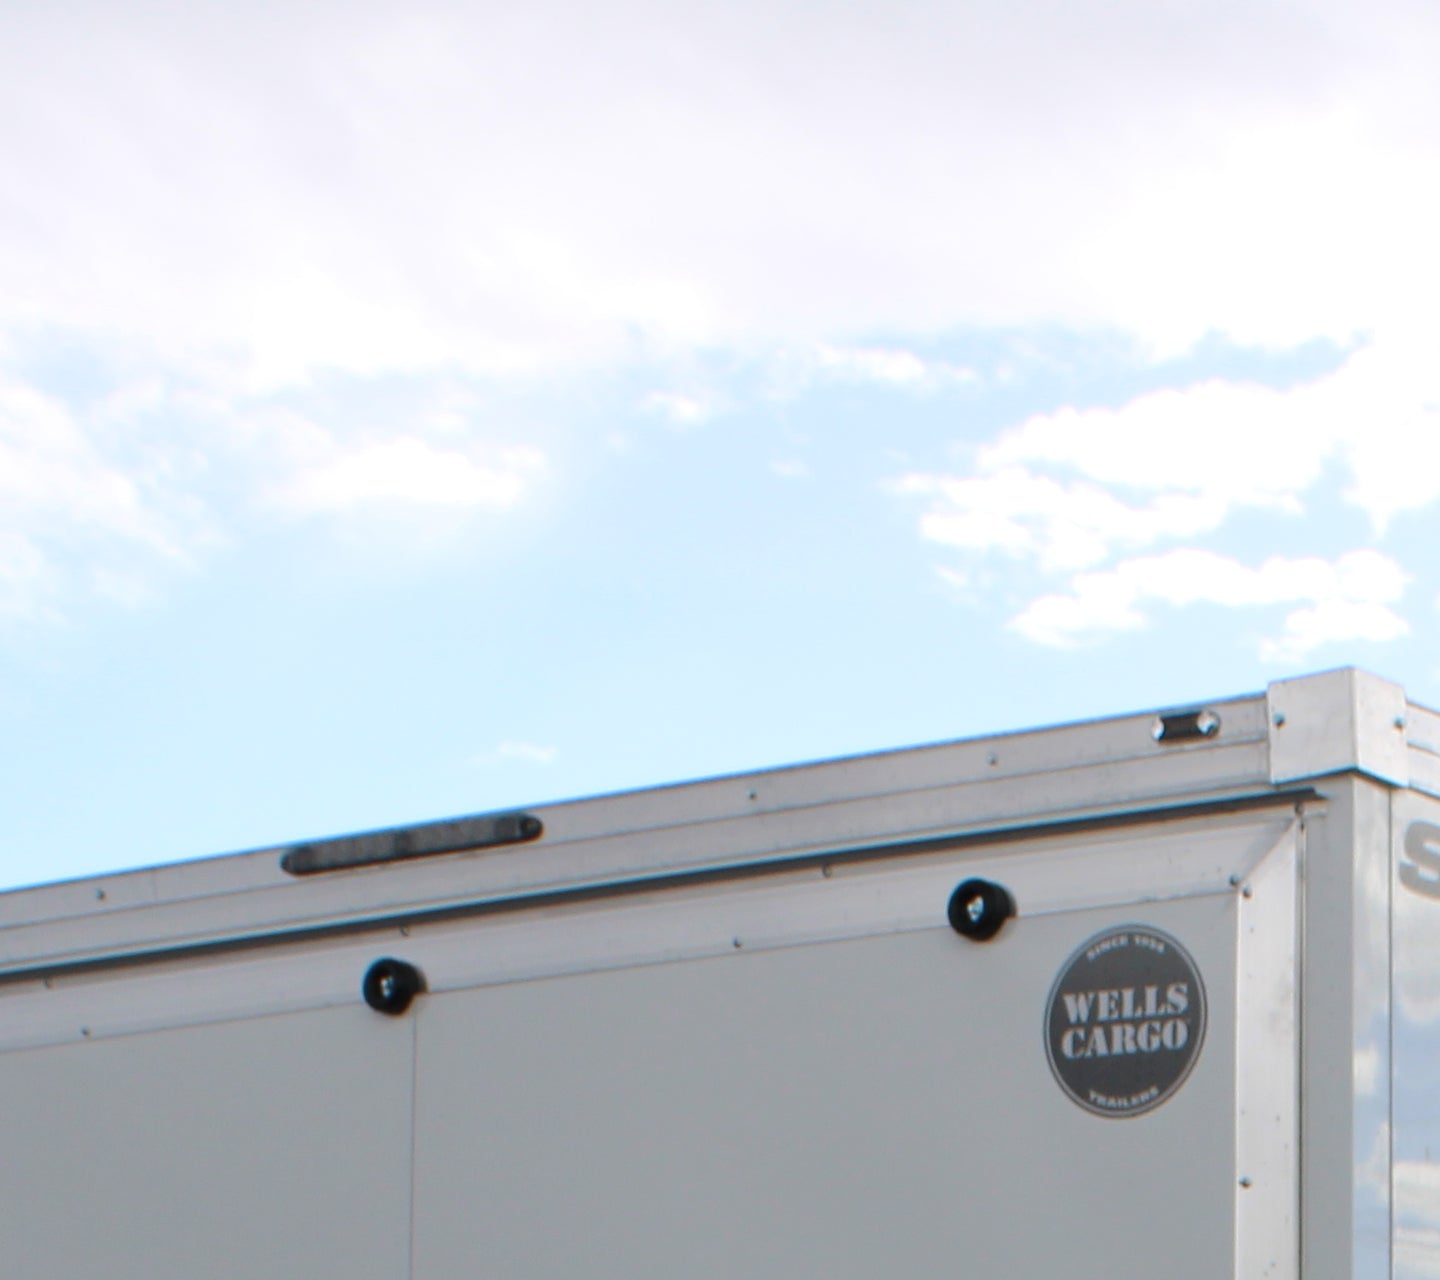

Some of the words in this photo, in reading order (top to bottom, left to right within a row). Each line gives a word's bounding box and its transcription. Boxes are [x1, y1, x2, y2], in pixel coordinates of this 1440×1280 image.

[1063, 981, 1188, 1024] WELLS
[1062, 1018, 1188, 1059] CARGO
[1089, 1085, 1160, 1109] TRAILERS
